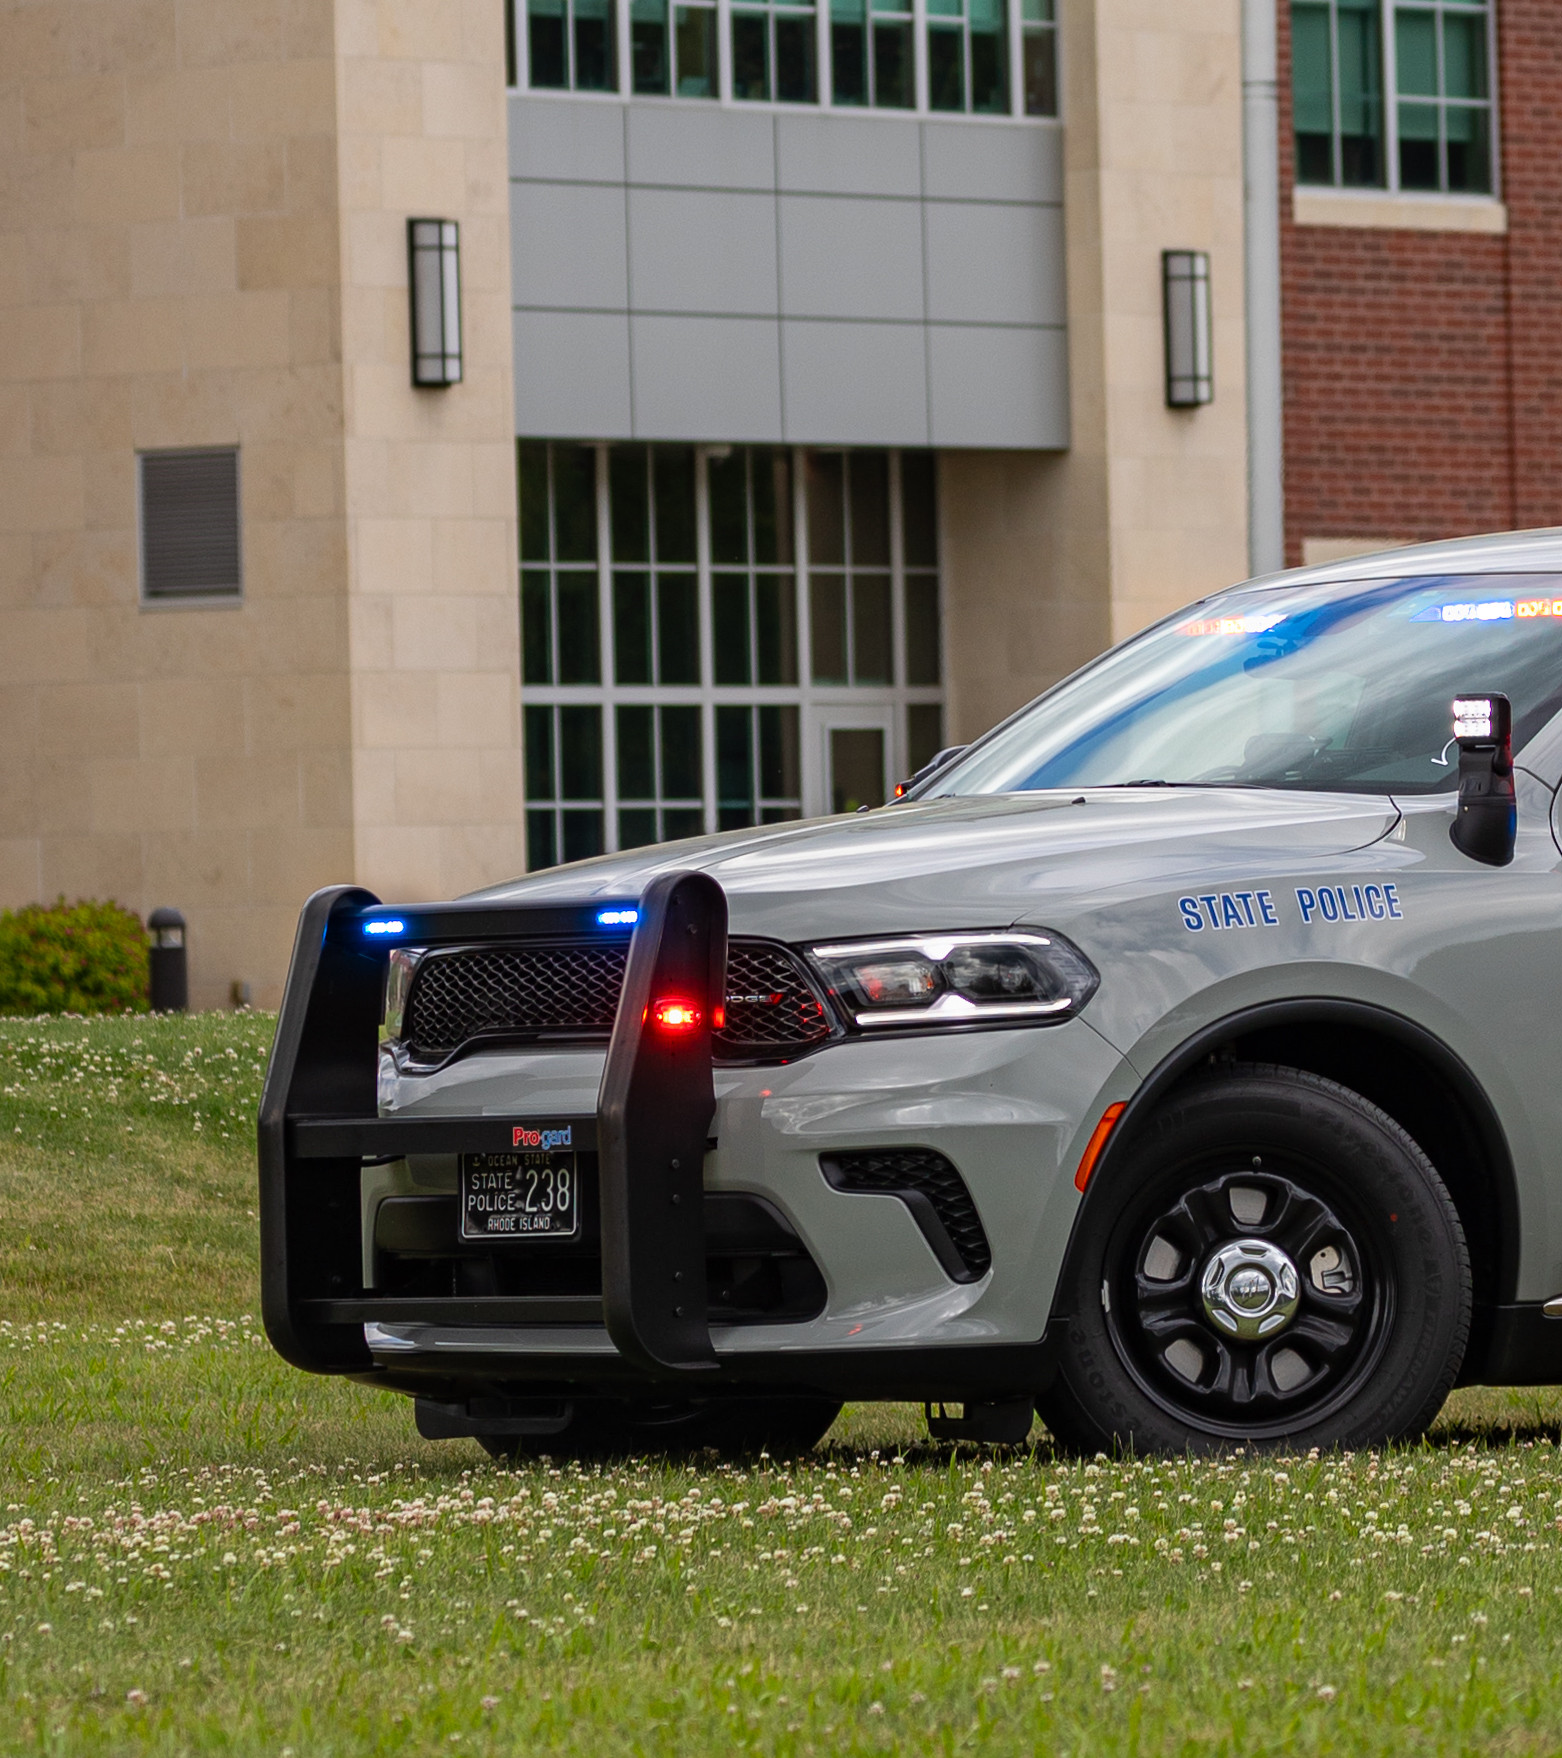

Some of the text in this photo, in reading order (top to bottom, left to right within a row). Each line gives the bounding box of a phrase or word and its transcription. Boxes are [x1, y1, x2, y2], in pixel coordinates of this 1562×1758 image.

[1179, 883, 1403, 932] STATE POLICE
[488, 1153, 551, 1166] OCEAN STATE
[471, 1173, 513, 1190] STATE
[524, 1168, 570, 1212] 238
[467, 1194, 516, 1212] POLICE
[488, 1217, 550, 1231] RHODE ISLAND
